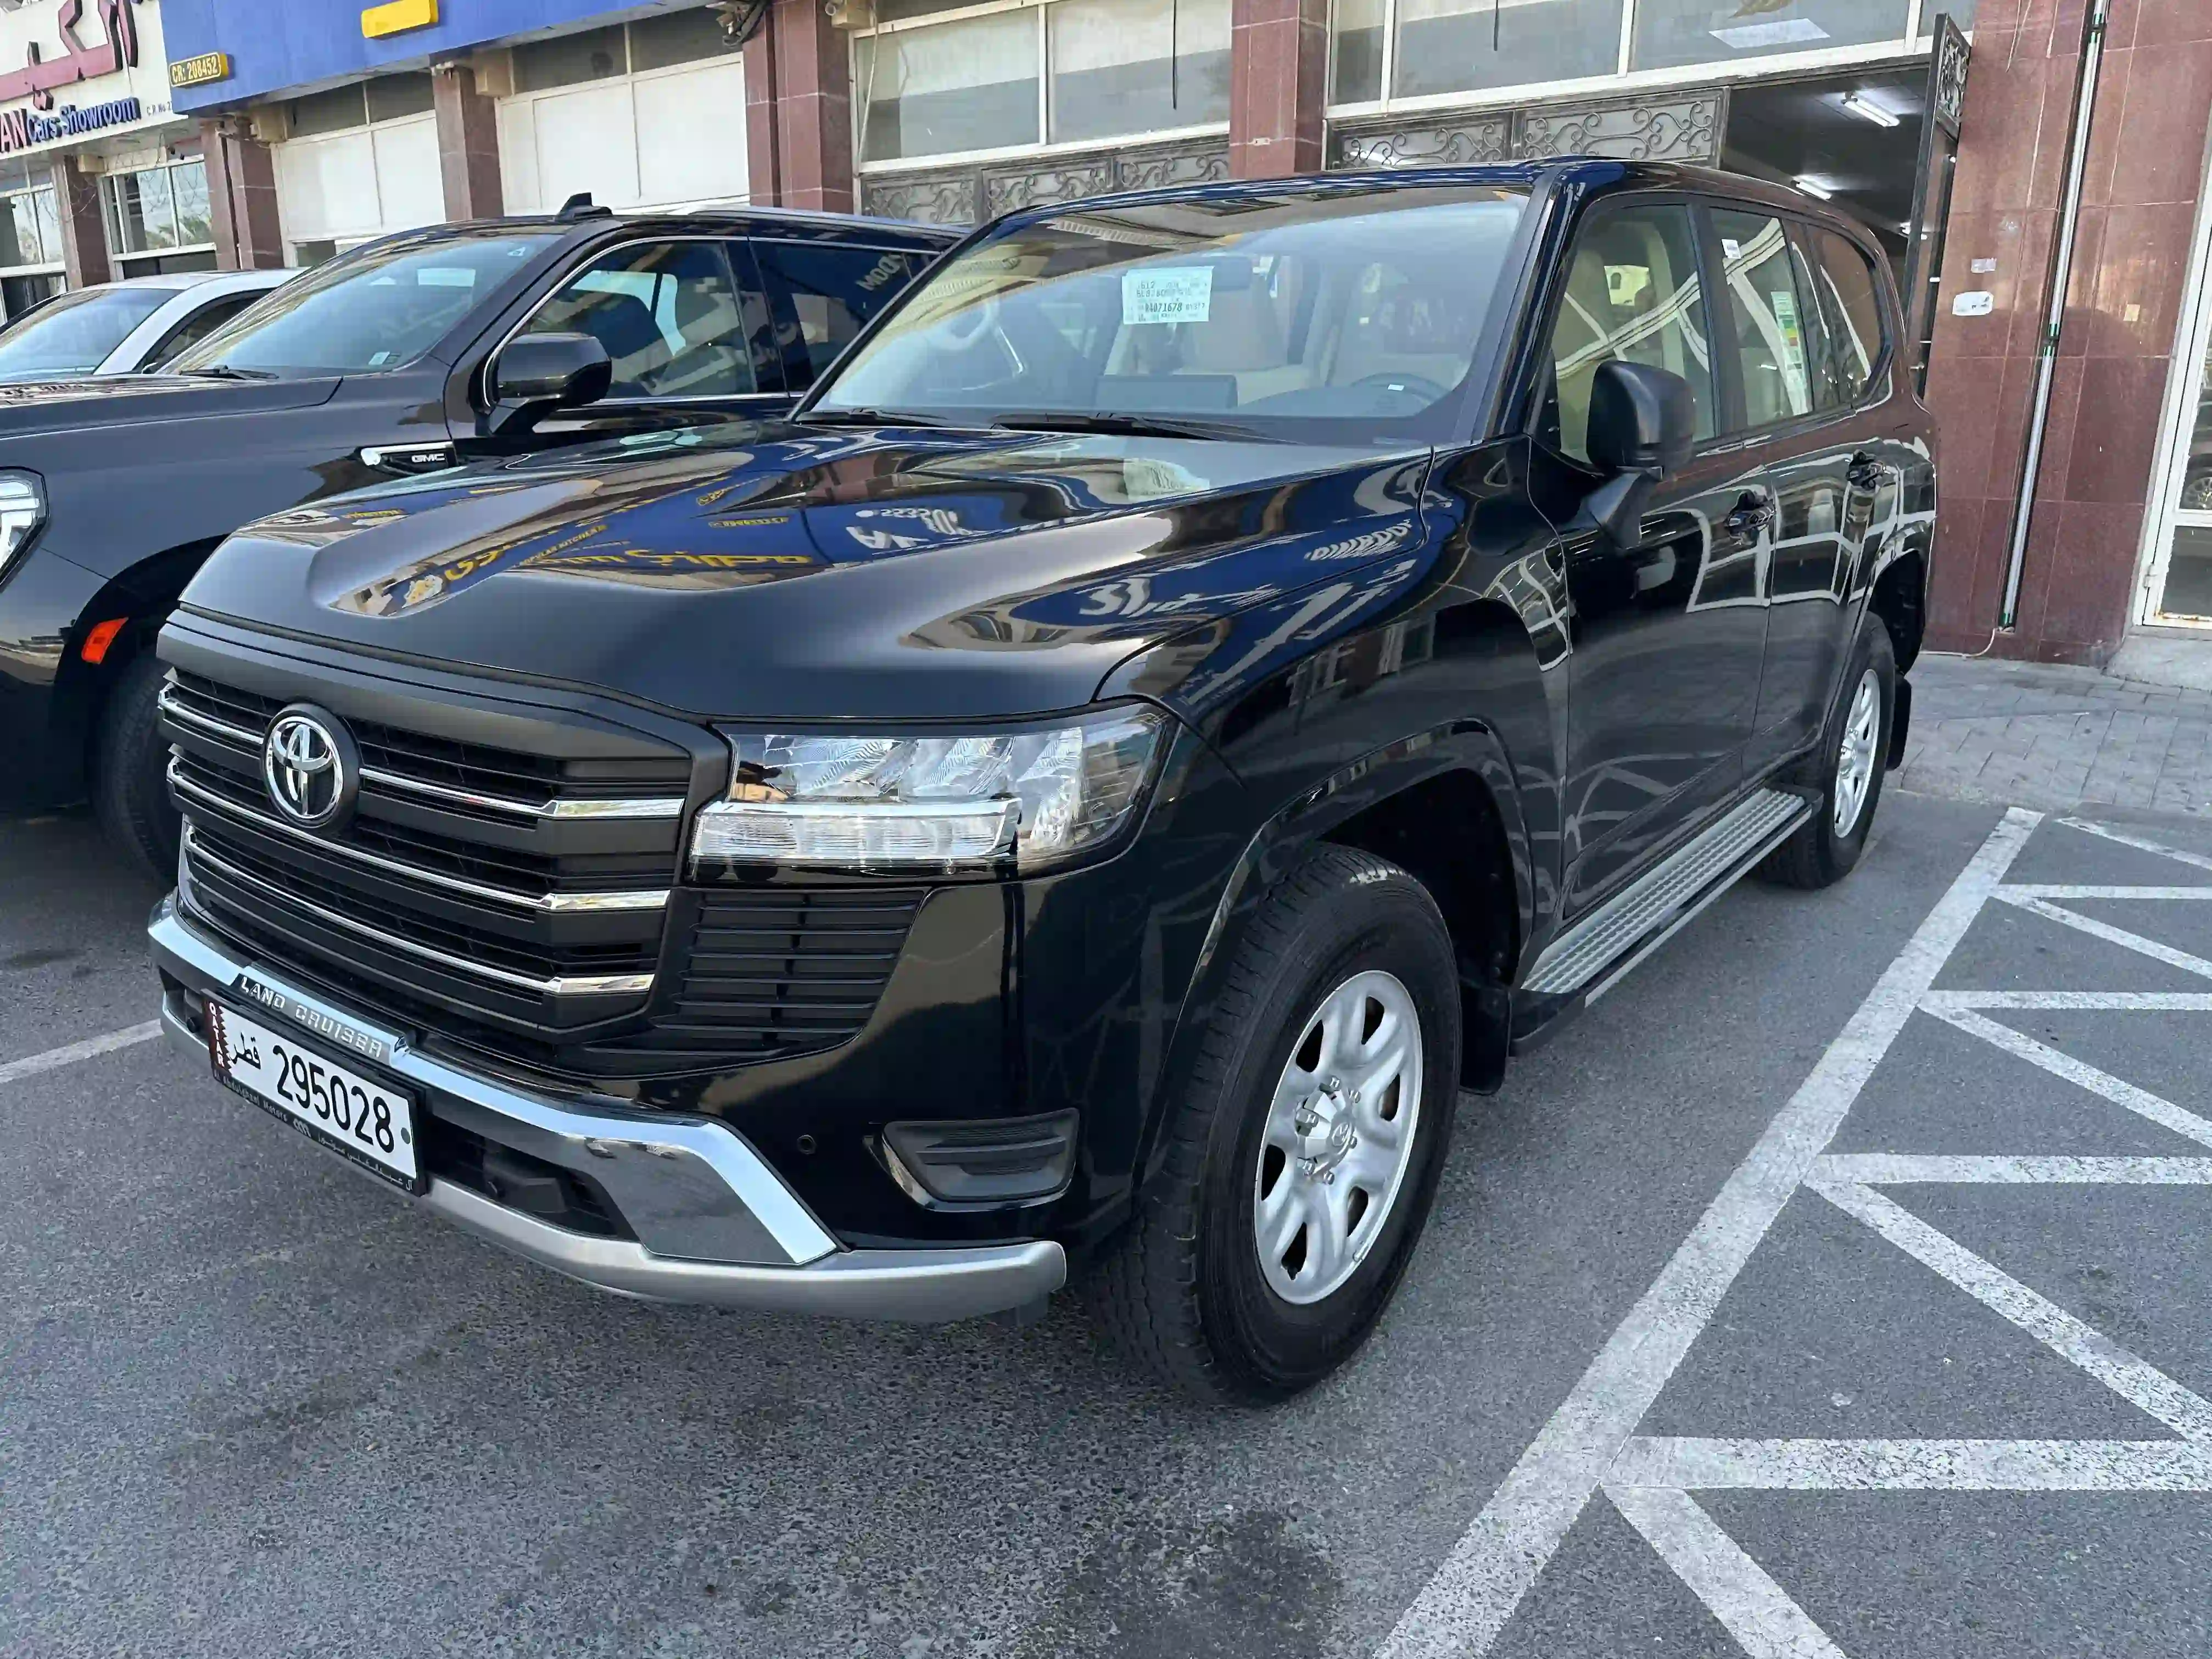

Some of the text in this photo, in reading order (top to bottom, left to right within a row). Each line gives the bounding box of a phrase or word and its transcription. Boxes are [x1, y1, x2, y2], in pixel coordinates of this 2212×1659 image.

[172, 55, 218, 83] CR: 208452
[60, 97, 141, 135] Showroom
[411, 453, 445, 463] GMC
[208, 1002, 225, 1067] QATAR
[241, 976, 383, 1059] LAND CRUISER
[228, 1031, 261, 1070] قطر
[272, 1044, 395, 1154] 295028
